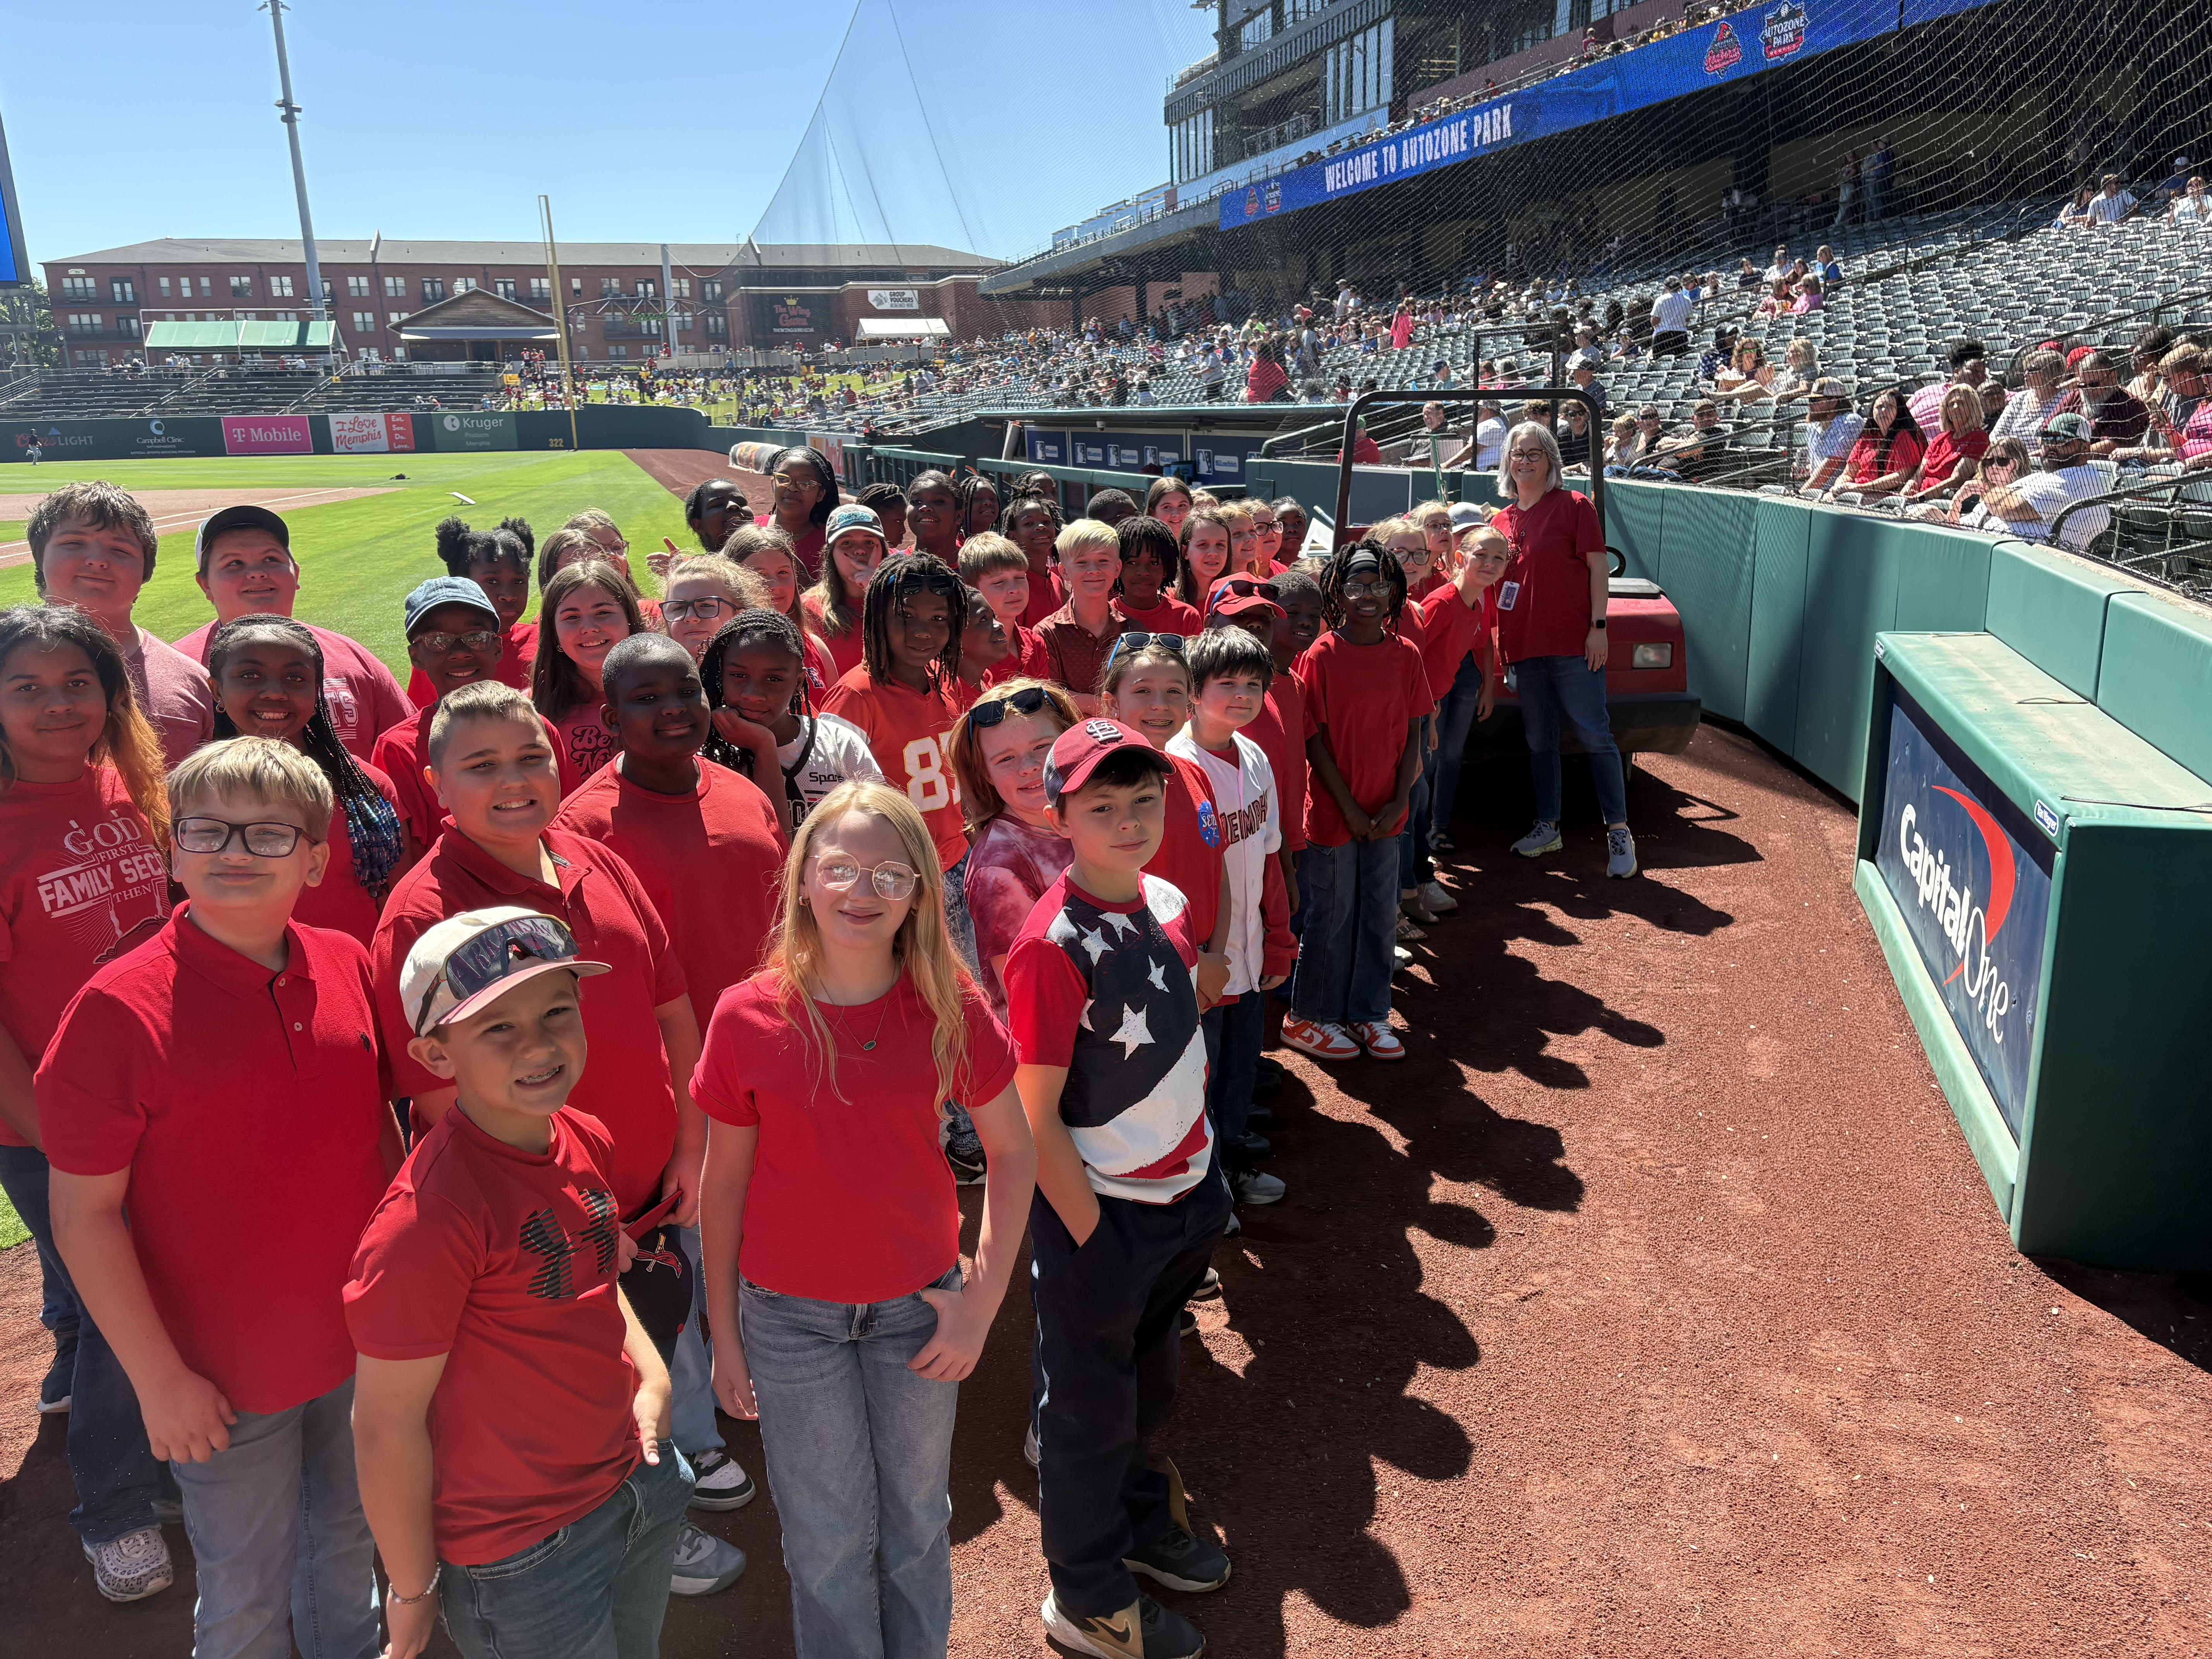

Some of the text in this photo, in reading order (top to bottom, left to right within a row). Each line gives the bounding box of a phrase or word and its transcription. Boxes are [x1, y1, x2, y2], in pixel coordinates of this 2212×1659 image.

[1764, 16, 1805, 39] AUTOZONE
[1773, 31, 1794, 47] PARK
[1325, 104, 1512, 193] WELCOME TO AUTOZONE PARK
[335, 421, 347, 432] I
[462, 417, 503, 430] Kruger
[58, 436, 93, 446] LIGHT
[248, 427, 302, 442] Mobile
[335, 429, 382, 450] Memphis
[548, 438, 564, 448] 322
[571, 725, 613, 752] Be
[570, 748, 611, 778] Ni
[64, 816, 142, 855] GOD
[98, 842, 136, 863] FIRST
[37, 852, 167, 913] FAMILY SEC
[113, 883, 152, 903] THEN
[1900, 804, 2008, 1044] Capital One
